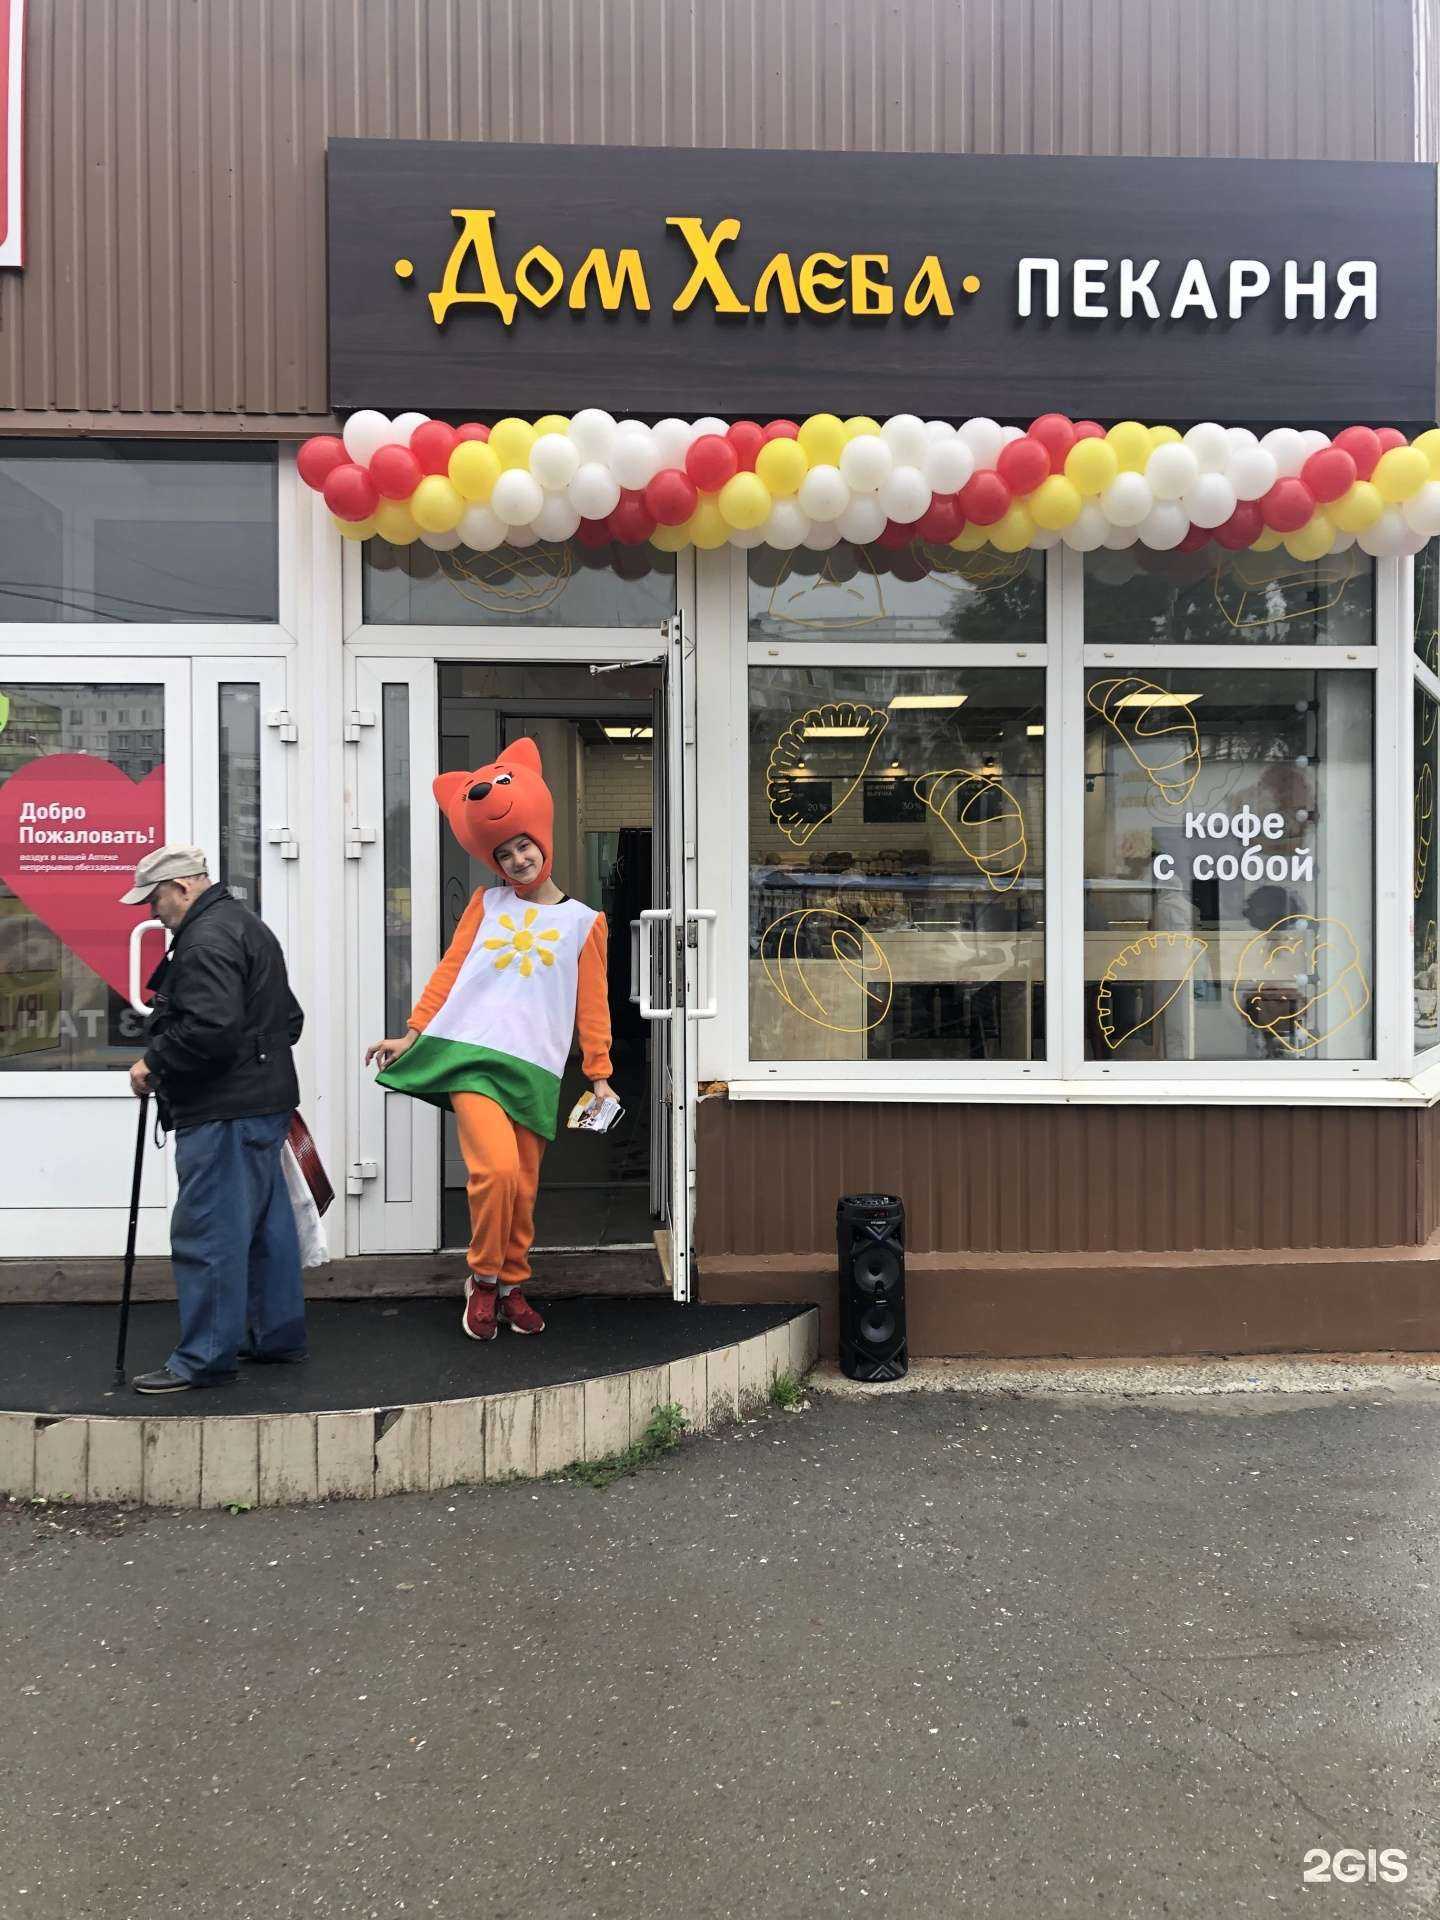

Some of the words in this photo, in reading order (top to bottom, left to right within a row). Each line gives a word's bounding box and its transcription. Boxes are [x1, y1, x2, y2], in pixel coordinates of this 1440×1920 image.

[1017, 257, 1379, 321] ПЕКАРНЯ
[19, 802, 86, 824] Добро
[1185, 804, 1285, 847] кофе
[19, 826, 155, 844] Пожаловать!
[58, 853, 87, 861] нашей
[1153, 854, 1175, 881] с
[1192, 844, 1314, 882] собой
